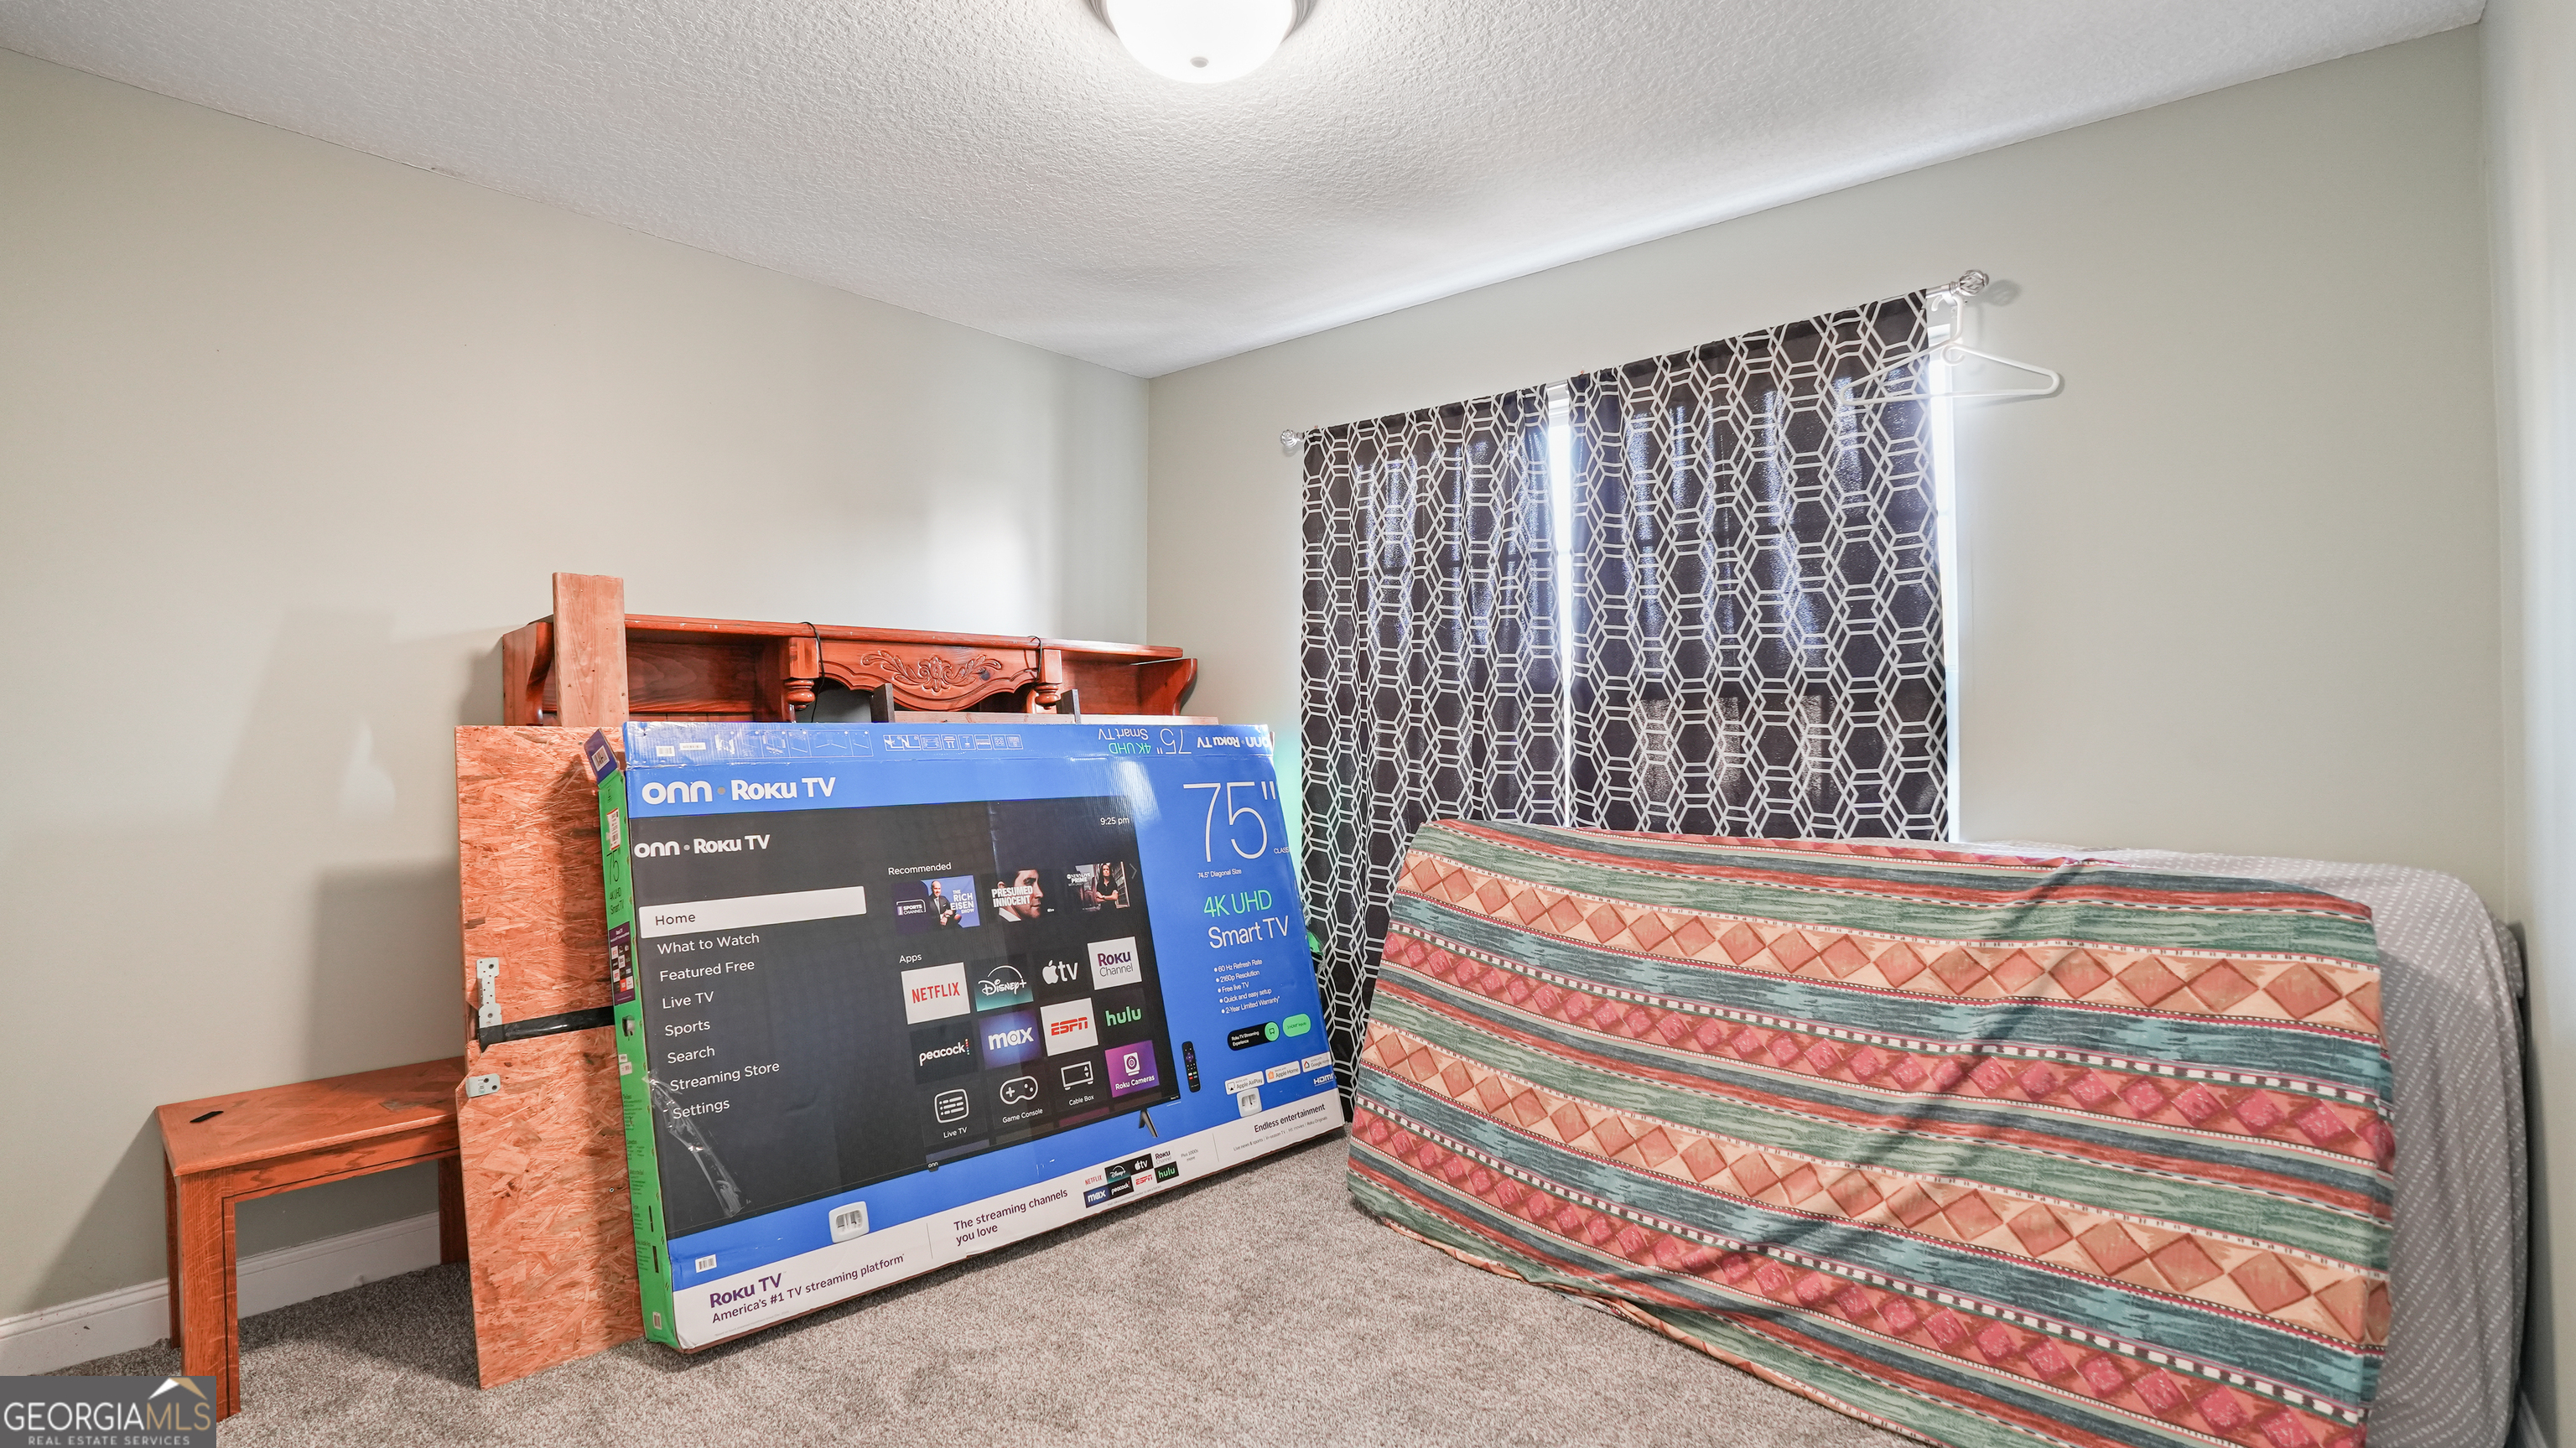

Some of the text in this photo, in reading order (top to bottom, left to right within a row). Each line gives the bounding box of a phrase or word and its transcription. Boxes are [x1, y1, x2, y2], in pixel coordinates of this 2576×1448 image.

[1098, 729, 1148, 740] Smart TV
[1109, 742, 1152, 754] 4K UHD
[1197, 737, 1213, 748] TV
[1214, 737, 1240, 747] Roku
[730, 779, 797, 801] Roku
[802, 777, 836, 798] TV
[1100, 817, 1130, 826] 9:25 pm
[1183, 781, 1276, 863] 75"
[693, 838, 742, 854] Roku
[745, 834, 771, 850] TV
[888, 862, 952, 876] Recommended
[1210, 869, 1231, 878] Diagonal
[953, 893, 973, 902] RICH
[991, 885, 1033, 899] PRESUMED
[950, 900, 974, 911] EISEN
[993, 895, 1031, 908] INNOCENT
[1204, 889, 1272, 918] 4K UHD
[655, 913, 696, 926] Home
[1208, 915, 1288, 949] Smart TV
[657, 933, 760, 955] What to Watch
[899, 953, 922, 964] Apps
[1098, 951, 1132, 967] Roku
[1233, 961, 1252, 970] Refresh
[660, 961, 755, 982] Featured Free
[1099, 963, 1134, 977] Channel
[1236, 970, 1260, 980] Resolution
[662, 991, 714, 1009] Live TV
[912, 982, 960, 1004] NETFLIX
[1223, 995, 1238, 1004] Quick
[1225, 1006, 1241, 1014] 2-Year
[1241, 1001, 1259, 1010] Limited
[1105, 1006, 1142, 1027] hulu
[665, 1020, 711, 1038] Sports
[1051, 1017, 1088, 1036] ESPN
[988, 1027, 1034, 1050] max
[667, 1046, 715, 1064] Search
[919, 1041, 966, 1067] peacock
[670, 1061, 780, 1091] Streaming Store
[1115, 1074, 1155, 1090] Roku Cameras
[1237, 1078, 1263, 1090] Apple AirPlay
[1069, 1094, 1095, 1106] Cable Box
[673, 1099, 730, 1120] Settings
[1002, 1108, 1043, 1123] Game Console
[1254, 1103, 1326, 1133] Endless entertainment
[943, 1126, 968, 1139] Live TV
[1155, 1150, 1171, 1160] Roku
[1136, 1174, 1153, 1185] ESPN
[1158, 1167, 1176, 1178] hulu
[1085, 1175, 1103, 1186] NETFLIX
[1111, 1183, 1130, 1195] peacock
[1088, 1190, 1106, 1203] max
[954, 1188, 1068, 1231] The streaming channels
[956, 1224, 998, 1246] you love
[709, 1284, 756, 1308] Roku
[712, 1298, 767, 1323] America's
[770, 1292, 785, 1305] #1
[787, 1286, 802, 1299] TV
[805, 1270, 858, 1294] streaming
